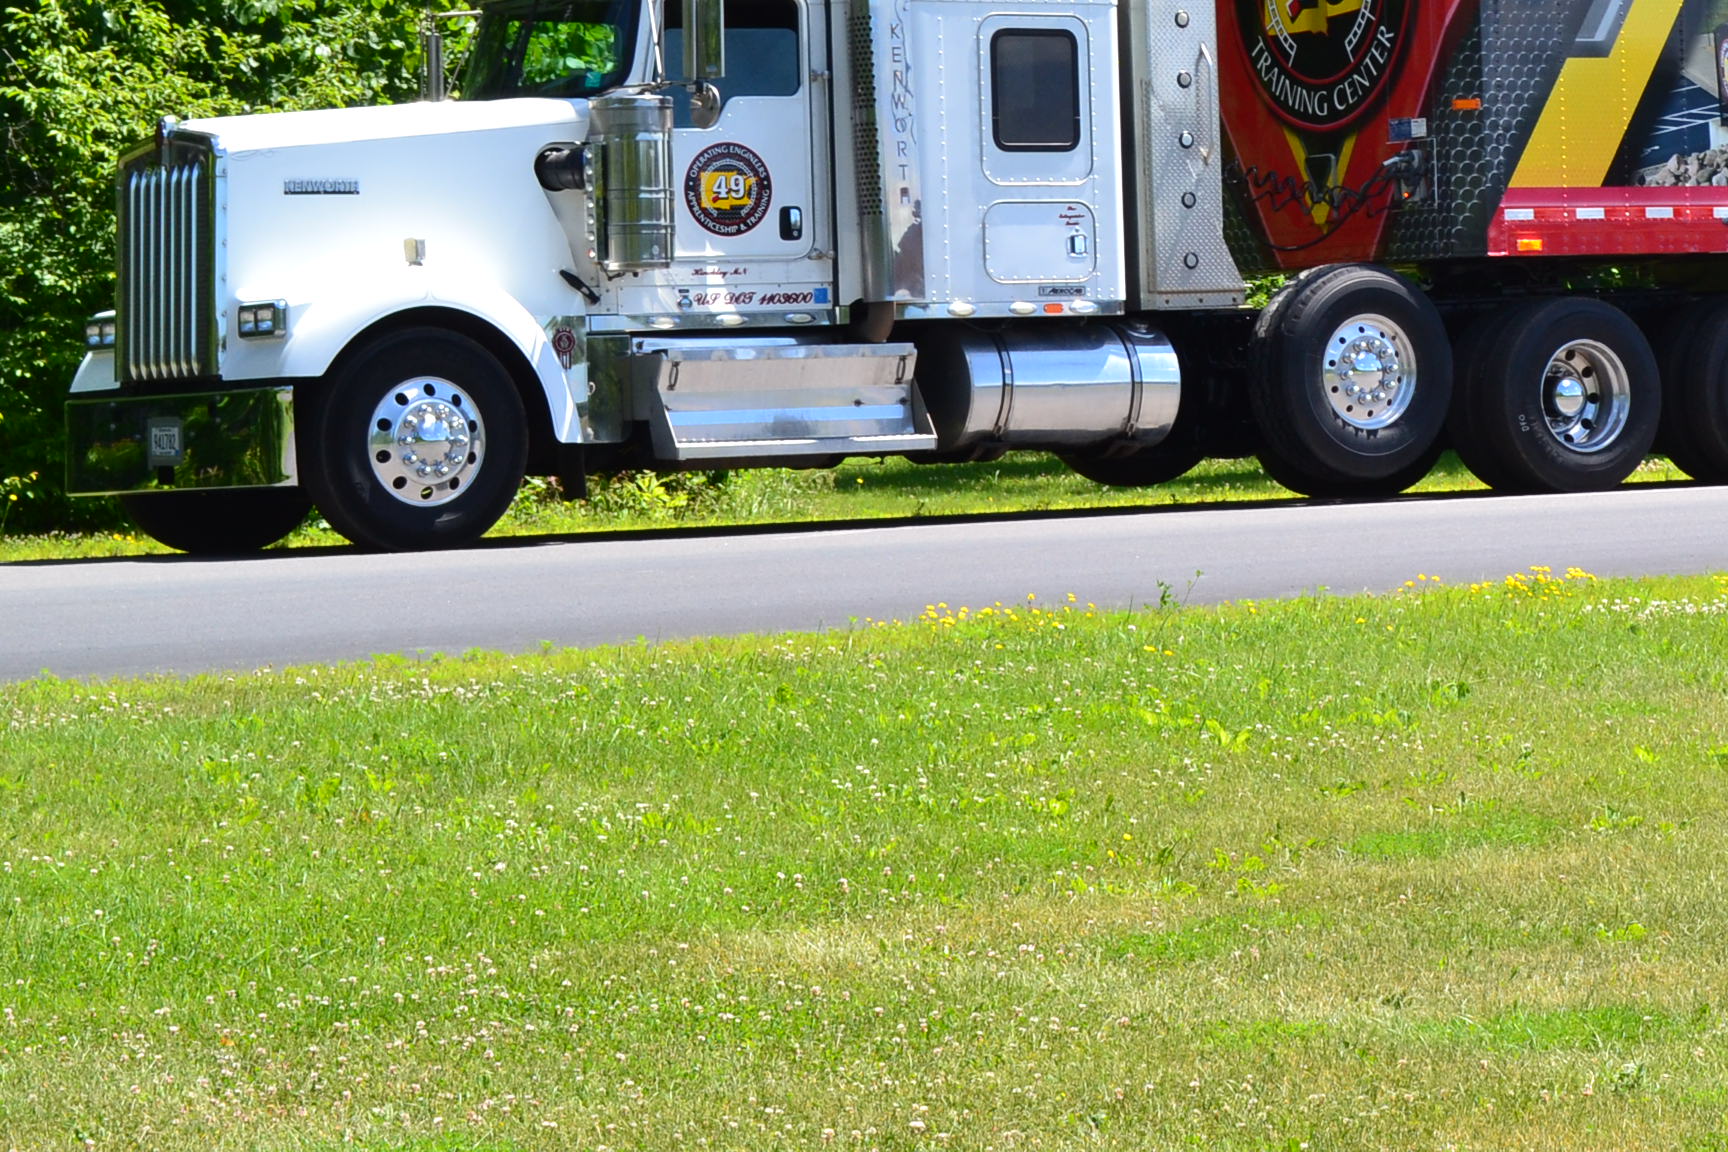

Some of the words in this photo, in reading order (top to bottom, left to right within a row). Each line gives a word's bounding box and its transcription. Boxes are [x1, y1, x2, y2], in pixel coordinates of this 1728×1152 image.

[1250, 35, 1328, 117] TRAINING
[1332, 23, 1396, 111] CENTER
[690, 145, 729, 178] OPERATING
[729, 145, 767, 178] ENGINEERS
[712, 174, 746, 199] 49
[688, 191, 739, 234] APPRENTICESHIP
[747, 189, 770, 226] TRAINING
